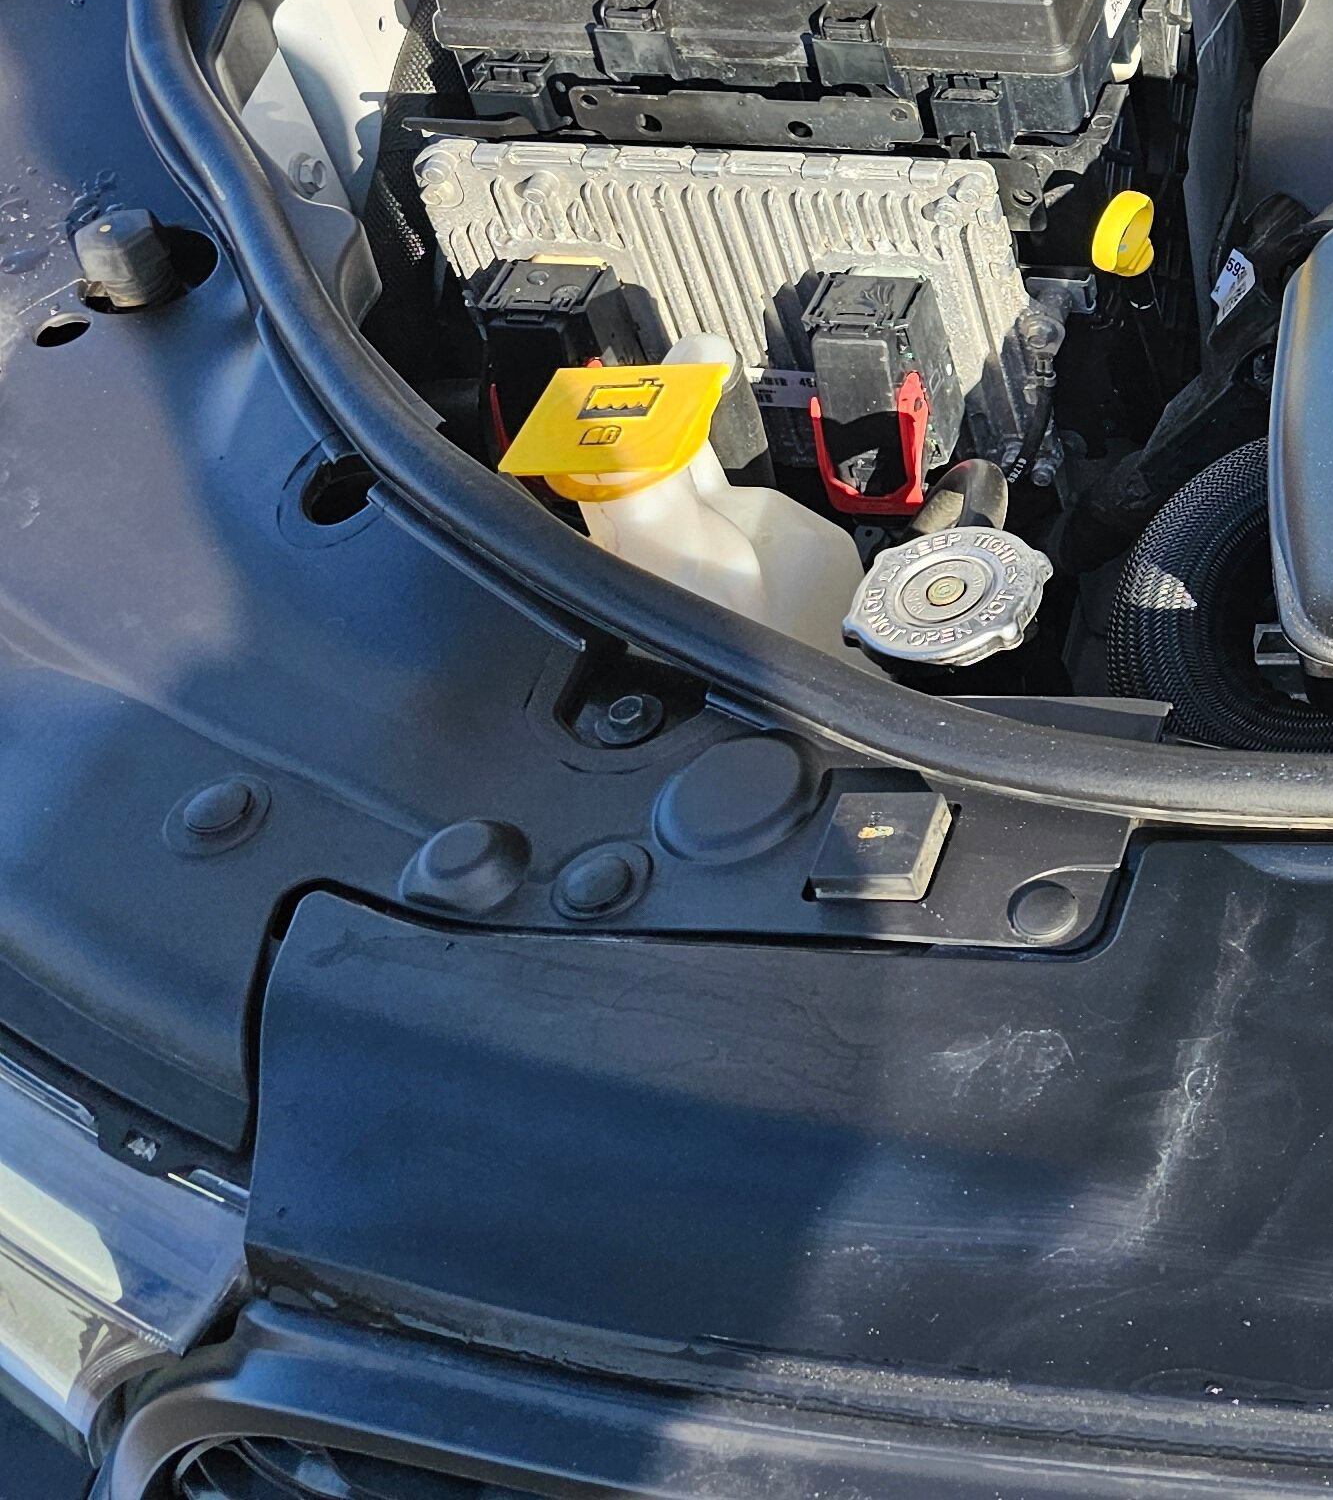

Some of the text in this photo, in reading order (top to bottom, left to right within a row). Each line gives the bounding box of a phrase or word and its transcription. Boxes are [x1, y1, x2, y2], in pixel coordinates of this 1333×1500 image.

[900, 532, 1023, 565] KEEP TIGHT
[863, 587, 886, 612] DO
[978, 588, 1016, 627] HOT
[866, 612, 907, 643] NOT
[906, 624, 973, 647] OPEN
